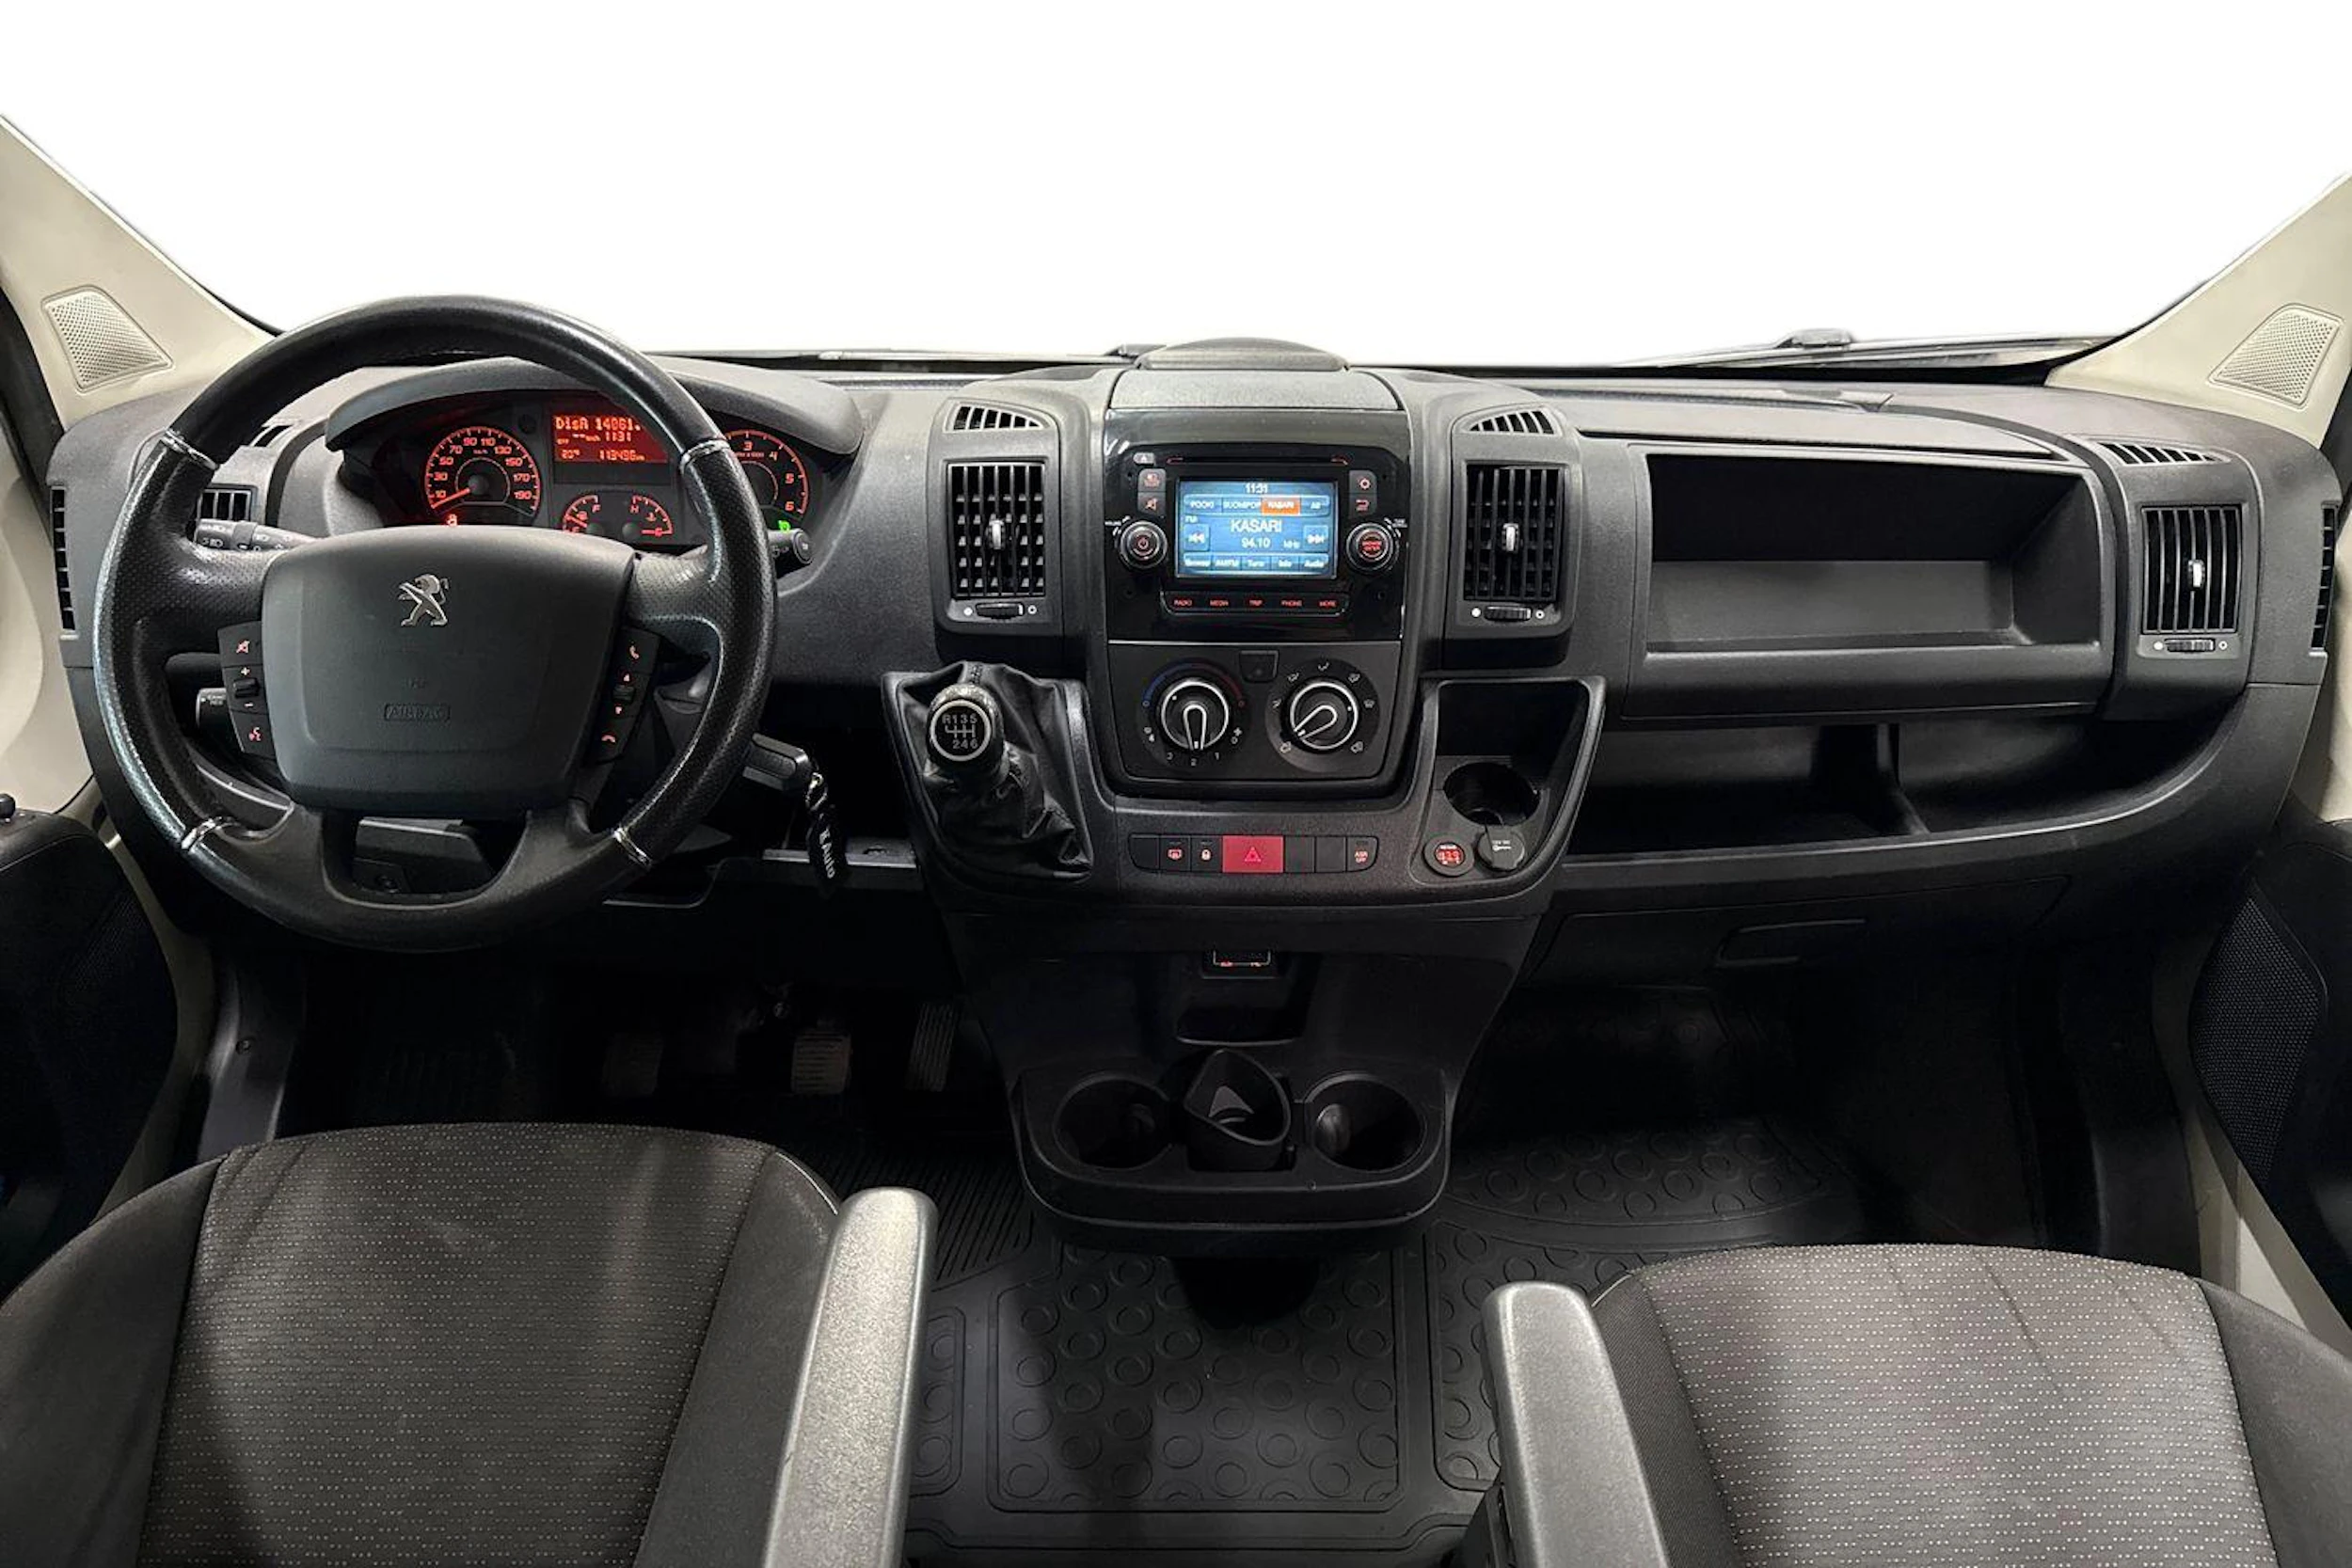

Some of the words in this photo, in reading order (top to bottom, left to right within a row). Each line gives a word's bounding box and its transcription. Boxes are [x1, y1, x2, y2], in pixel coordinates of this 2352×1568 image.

[463, 437, 477, 446] 90
[481, 437, 496, 446] 110
[743, 441, 753, 451] 3
[450, 445, 463, 454] 70
[494, 446, 512, 454] 130
[438, 456, 453, 466] 50
[769, 451, 778, 461] 4
[505, 457, 523, 467] 150
[434, 472, 448, 481] 30
[514, 473, 531, 482] 170
[785, 473, 794, 483] 5
[514, 490, 532, 499] 190
[785, 501, 794, 511] 6
[1230, 518, 1282, 533] KASARI
[1241, 537, 1271, 548] 94.10
[943, 715, 951, 723] R
[961, 715, 968, 723] 3
[970, 714, 977, 723] 5
[953, 740, 960, 749] 2
[961, 740, 968, 749] 4
[970, 739, 977, 749] 6
